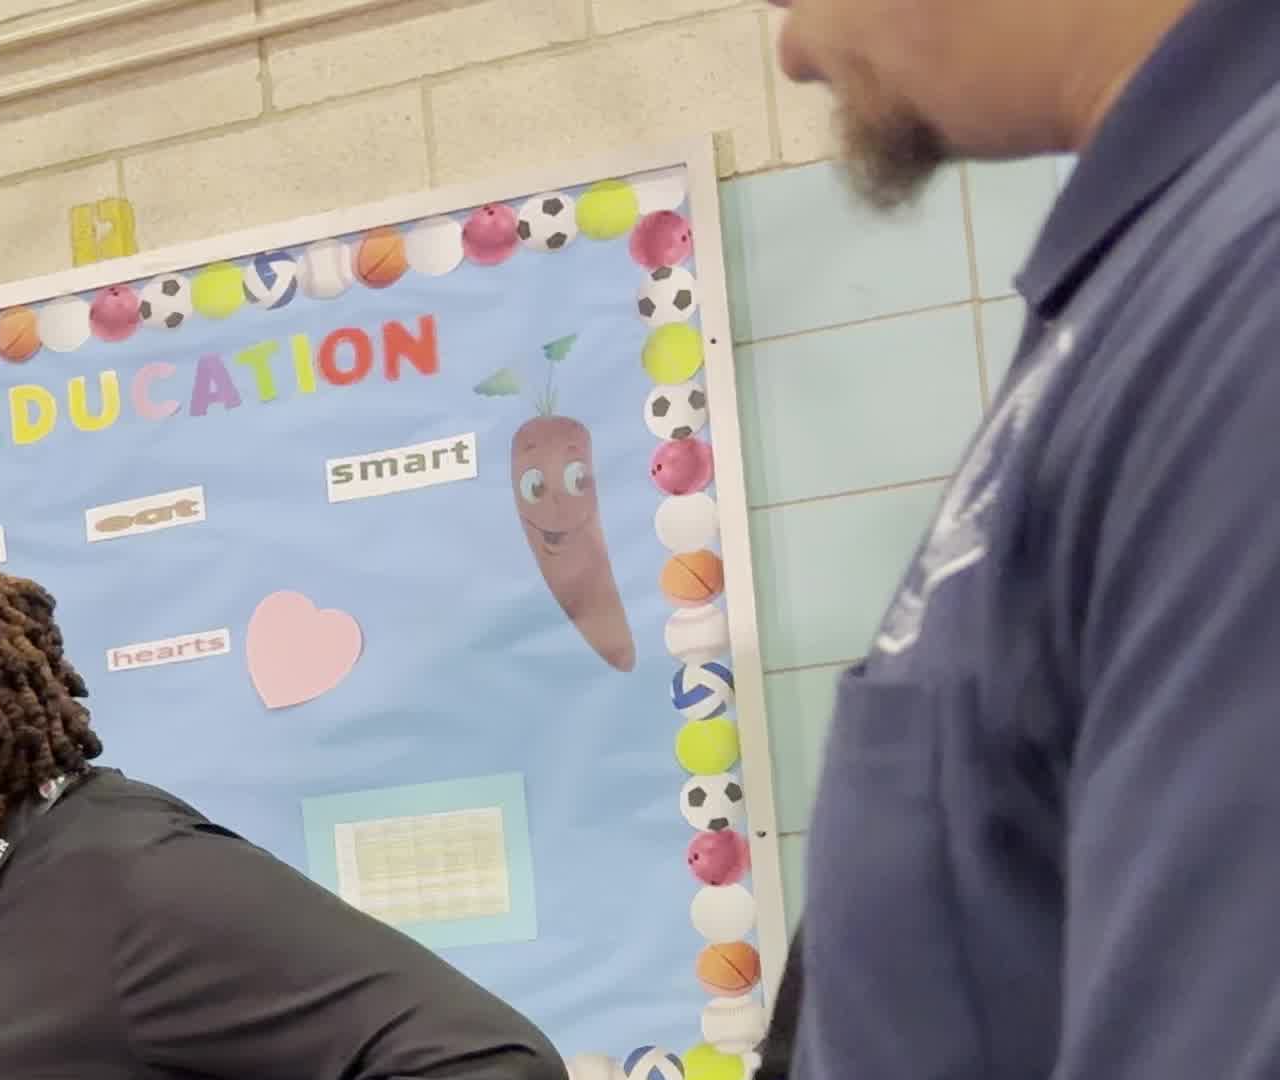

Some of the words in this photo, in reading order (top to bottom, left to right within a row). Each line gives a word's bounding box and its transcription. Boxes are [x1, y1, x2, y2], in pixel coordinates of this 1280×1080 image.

[330, 438, 471, 485] smart
[94, 495, 201, 534] eat
[111, 635, 226, 668] hearts
